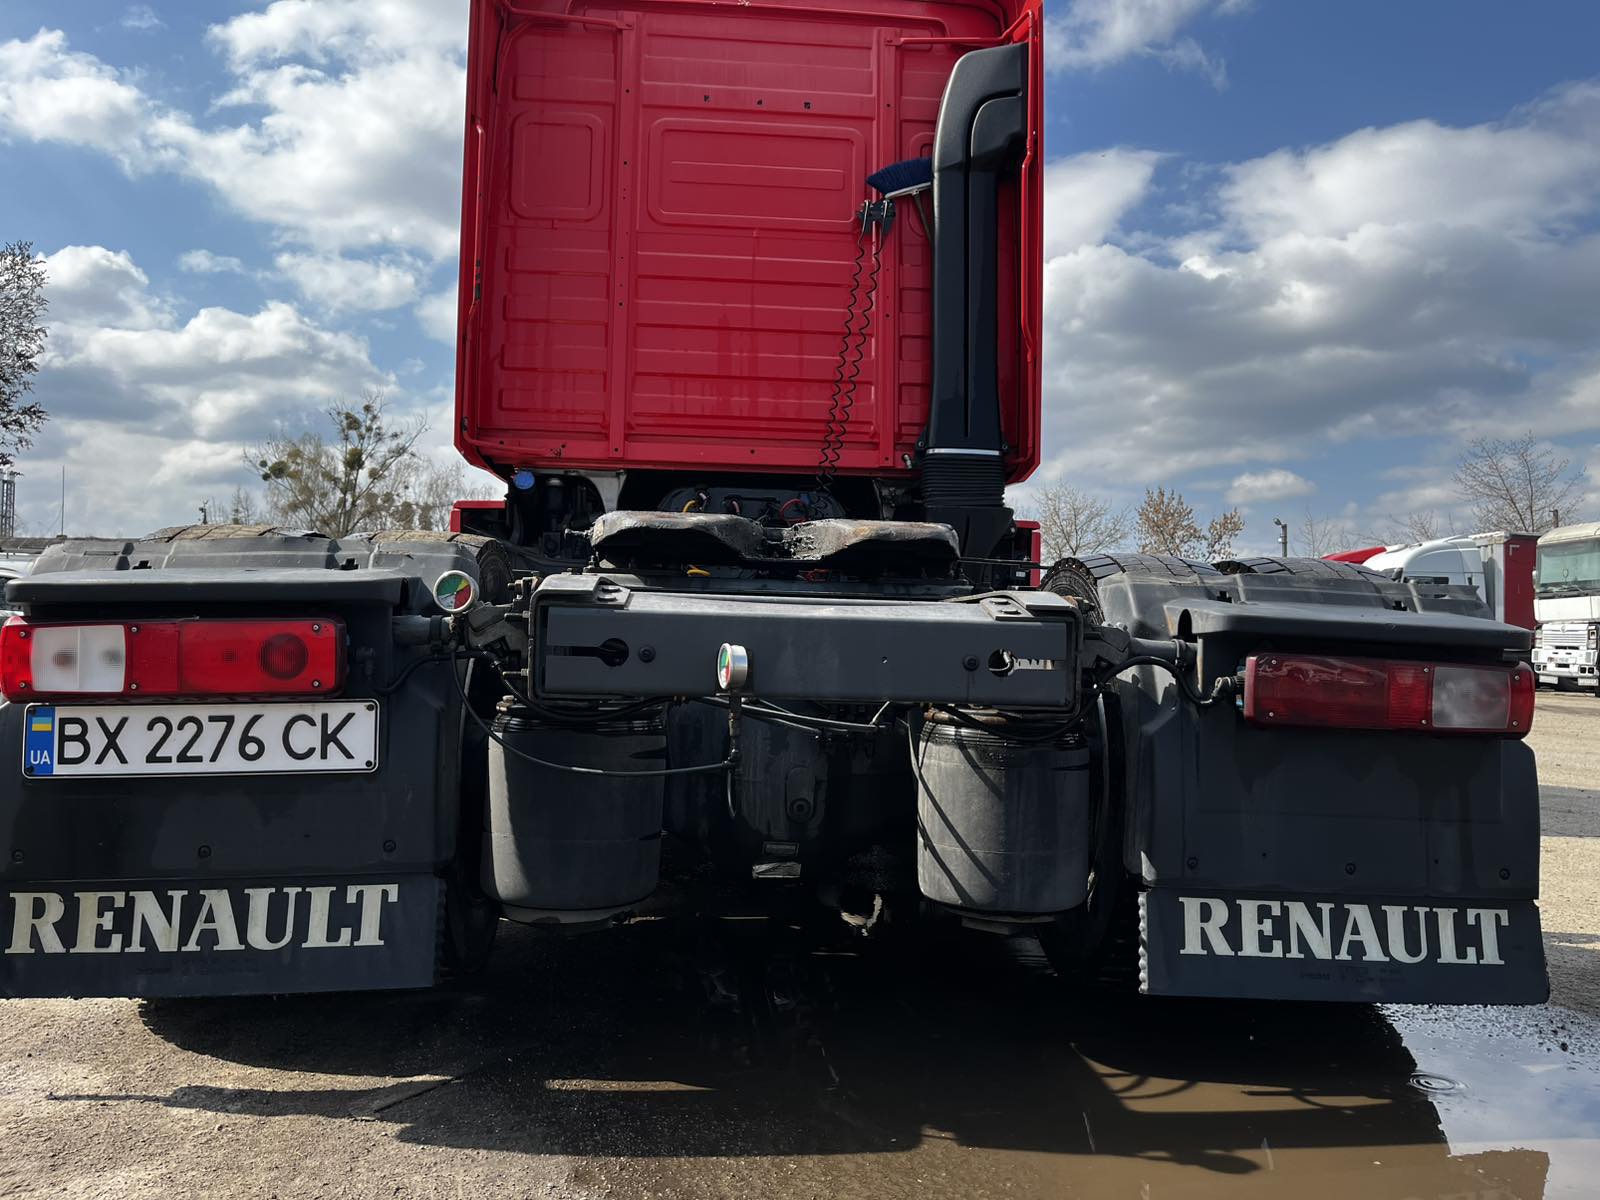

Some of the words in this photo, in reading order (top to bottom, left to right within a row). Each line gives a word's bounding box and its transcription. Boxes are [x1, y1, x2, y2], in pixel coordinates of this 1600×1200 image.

[30, 750, 51, 765] UA
[57, 716, 129, 766] BX
[145, 714, 265, 765] 2276
[281, 712, 356, 761] CK
[4, 883, 399, 955] RENAULT
[1178, 896, 1510, 966] RENAULT
